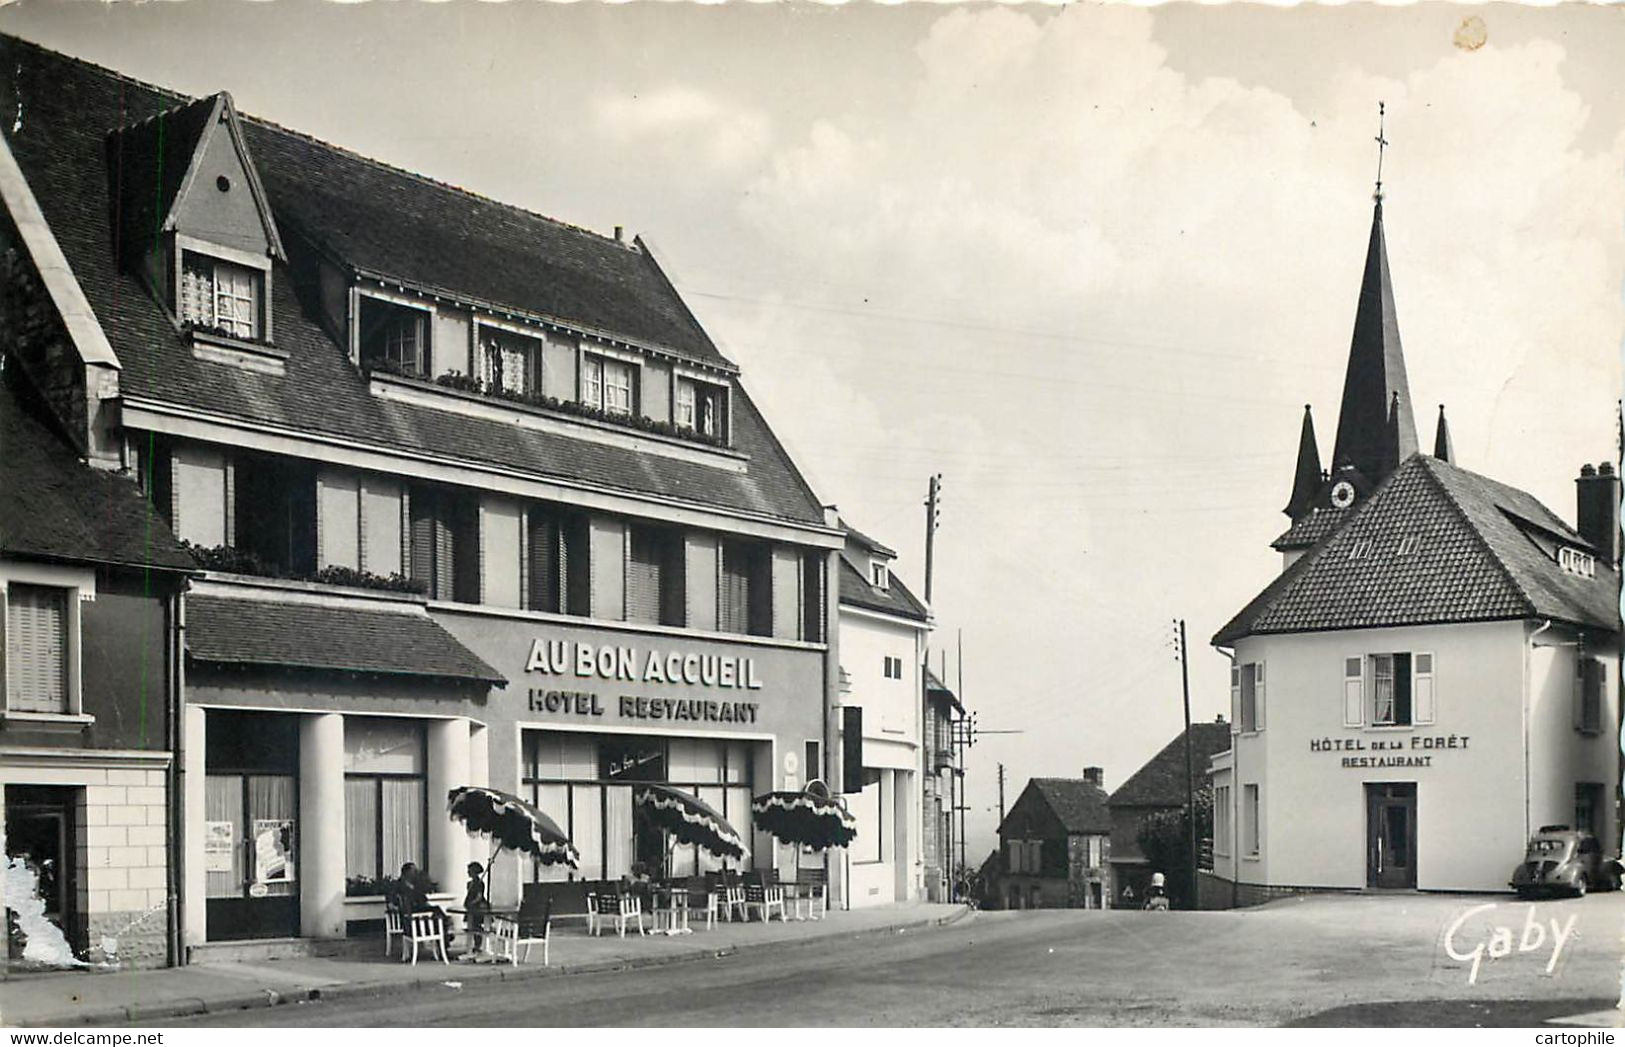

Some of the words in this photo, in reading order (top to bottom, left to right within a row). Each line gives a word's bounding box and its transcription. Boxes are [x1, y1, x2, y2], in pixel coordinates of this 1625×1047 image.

[525, 639, 569, 674] AU
[575, 642, 637, 680] BON
[642, 650, 763, 689] ACCUEIL
[528, 688, 604, 715] HOTEL
[619, 695, 759, 723] RESTAURANT
[1310, 737, 1366, 751] HÔTEL
[1371, 741, 1385, 750] DE
[1390, 741, 1402, 750] LA
[1411, 734, 1470, 750] FORÊT
[1342, 756, 1432, 768] RESTAURANT
